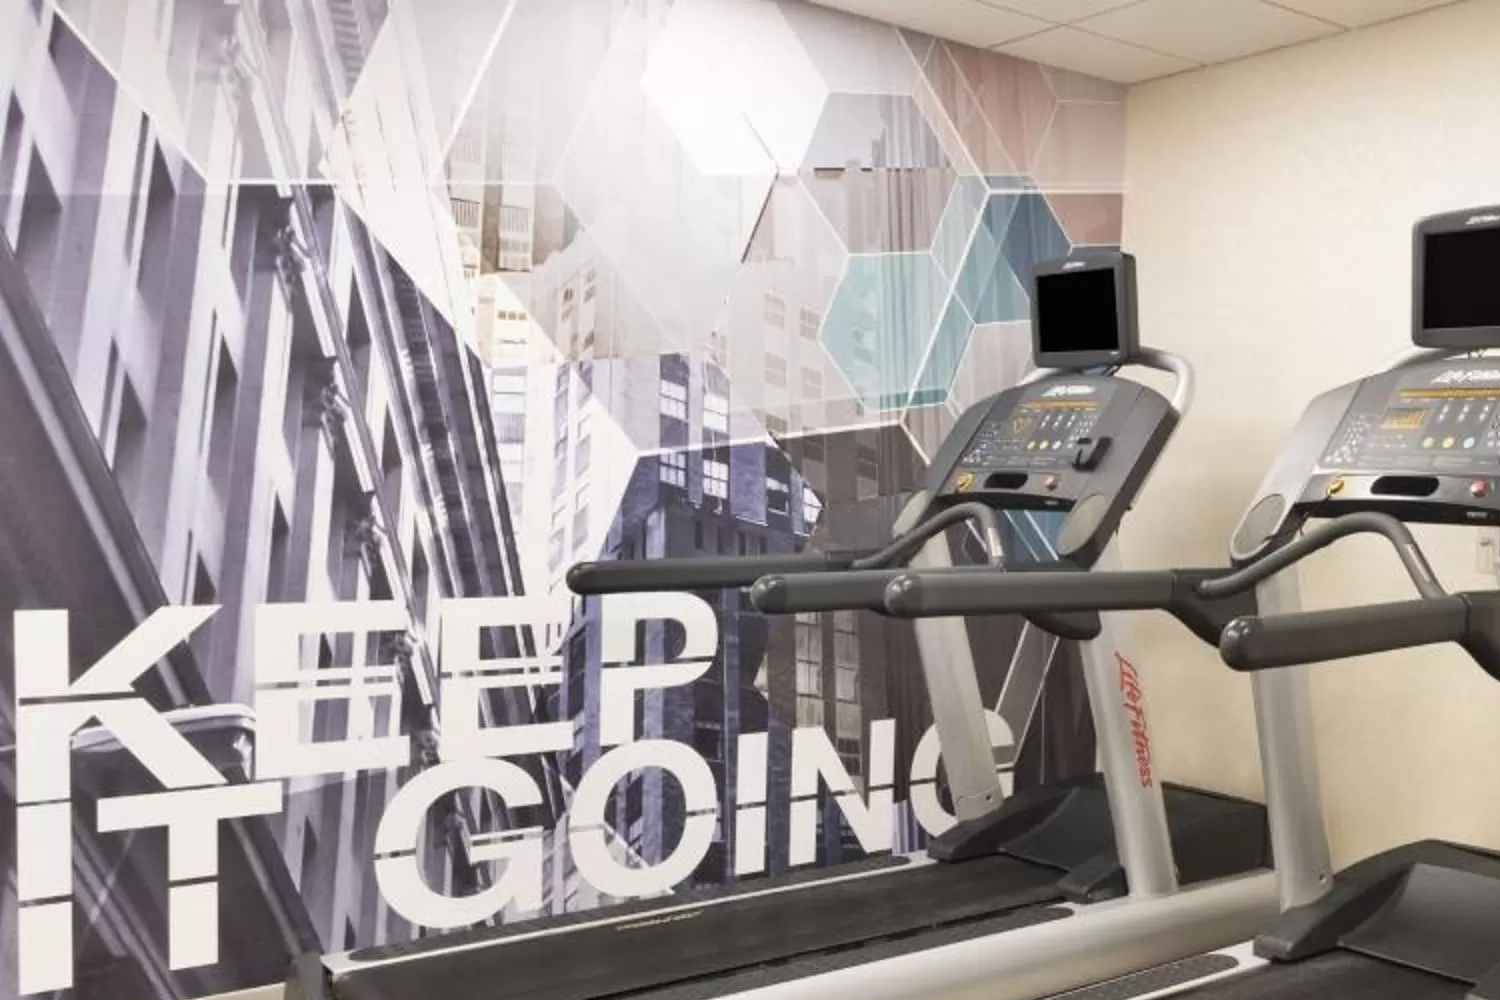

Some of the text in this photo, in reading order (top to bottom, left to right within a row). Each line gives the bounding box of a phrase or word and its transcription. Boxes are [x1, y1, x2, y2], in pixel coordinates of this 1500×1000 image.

[13, 591, 719, 801] KEEP
[17, 708, 1015, 995] IT GOING
